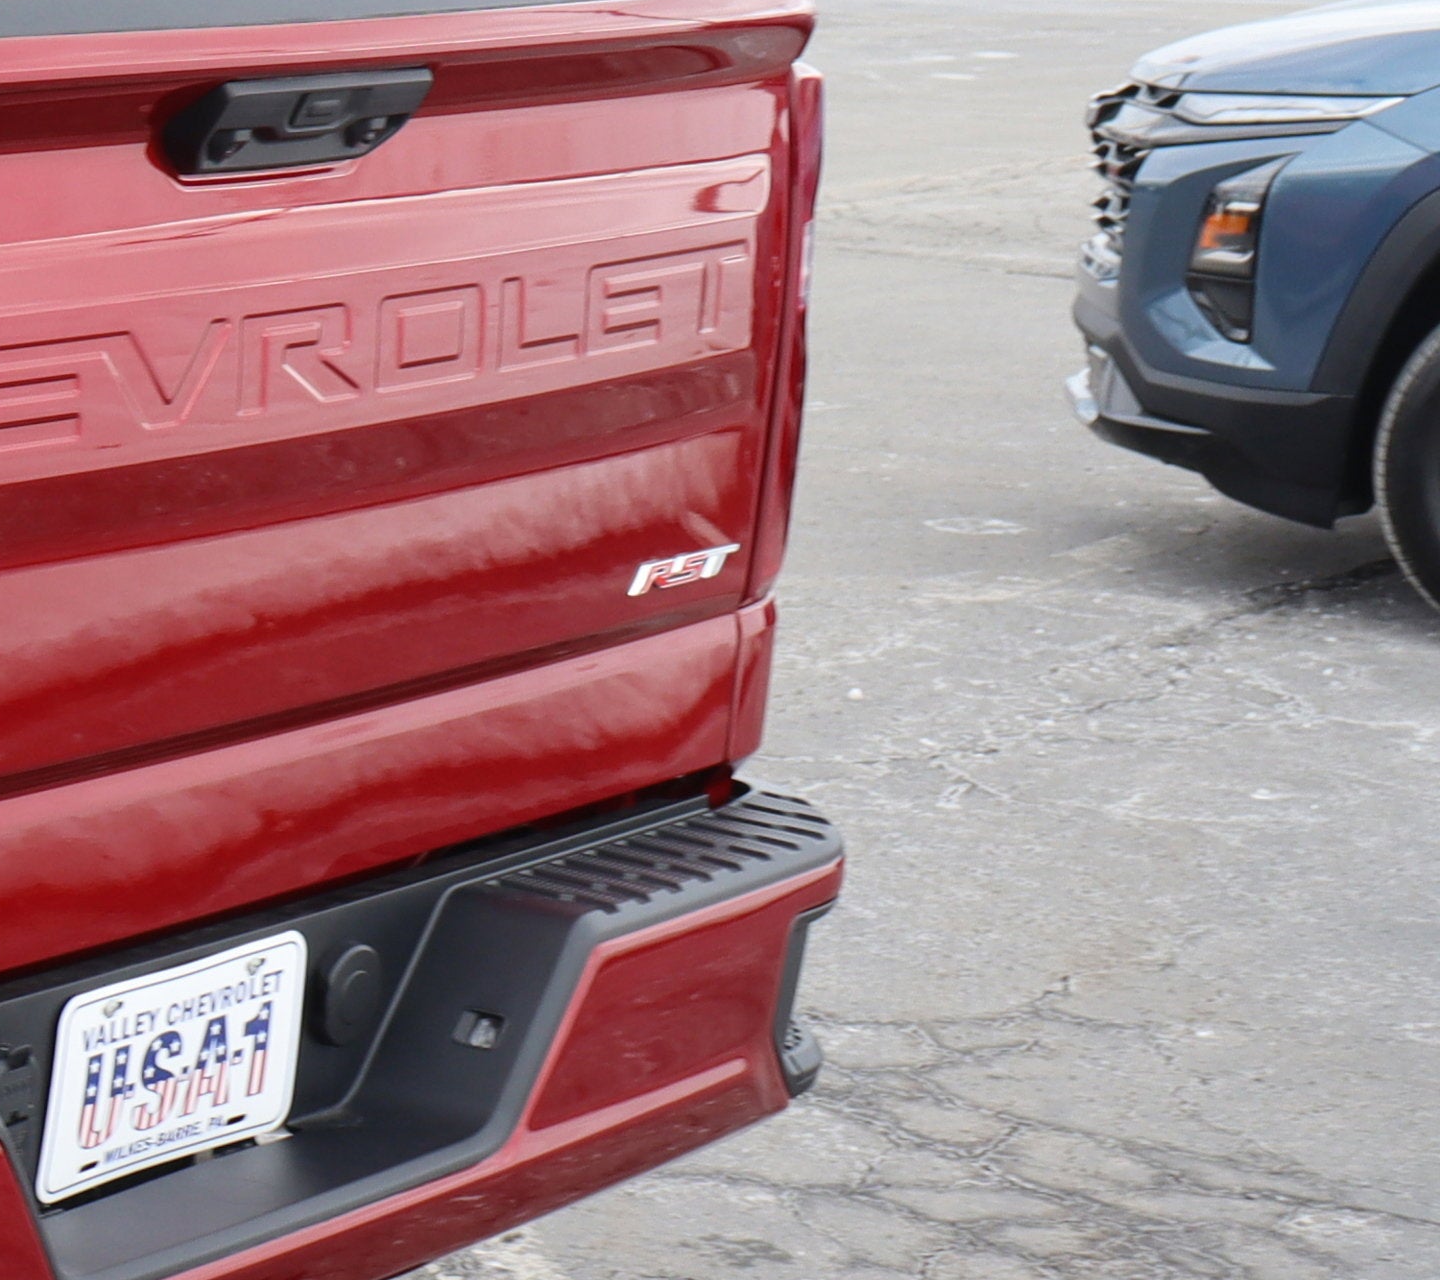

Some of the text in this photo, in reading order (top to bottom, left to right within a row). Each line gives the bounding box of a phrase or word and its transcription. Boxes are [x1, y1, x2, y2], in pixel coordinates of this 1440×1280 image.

[626, 542, 741, 597] RST
[82, 969, 285, 1052] VALLEY CHEVROLET
